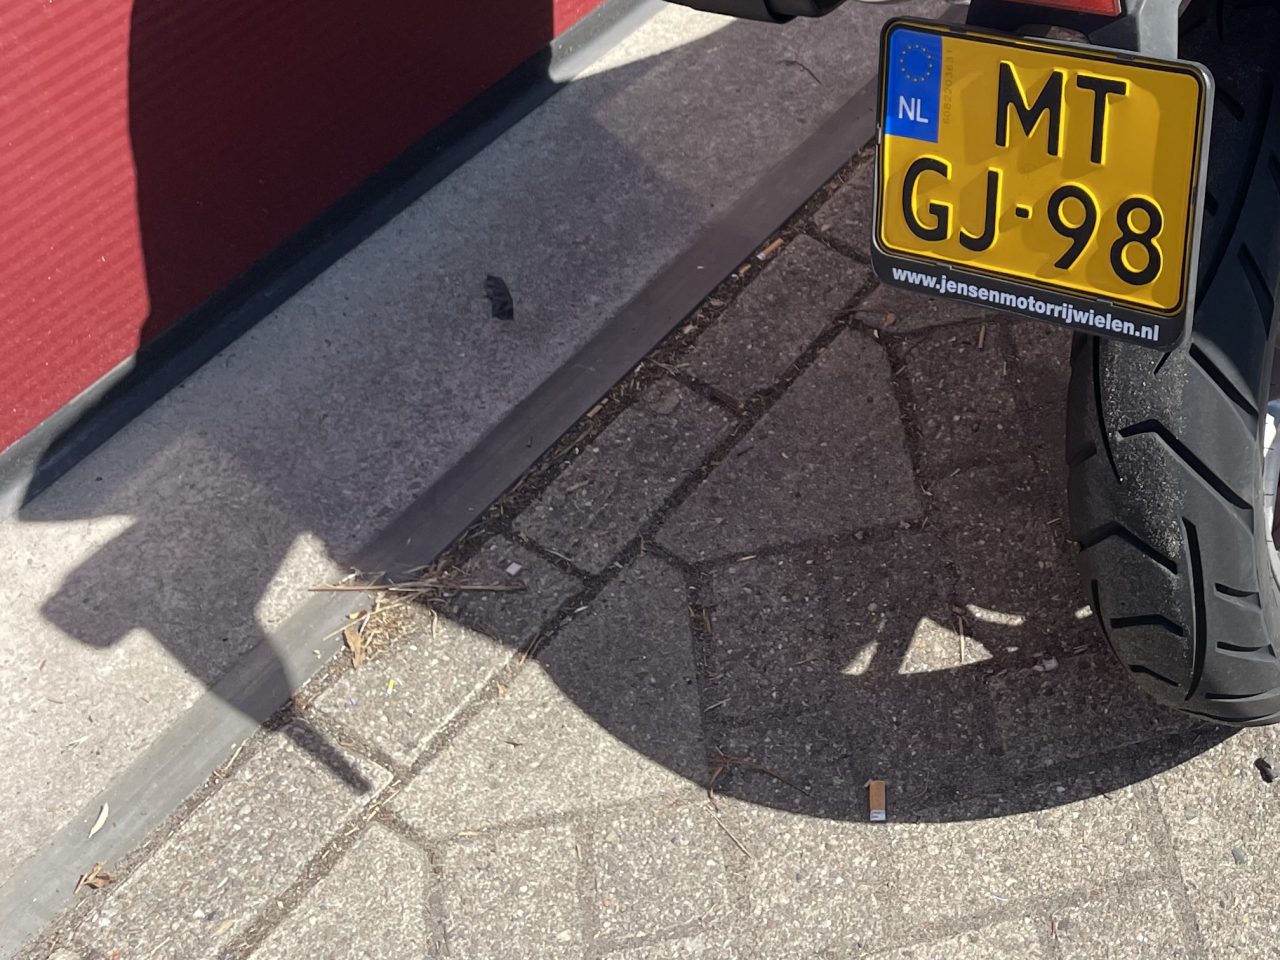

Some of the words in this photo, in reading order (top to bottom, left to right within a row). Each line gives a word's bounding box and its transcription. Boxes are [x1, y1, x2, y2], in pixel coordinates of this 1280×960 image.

[898, 96, 929, 123] NL
[996, 61, 1129, 165] MT
[902, 155, 1163, 286] GJ-98
[892, 266, 1159, 341] www.jensenmotorrijwielen.nl
